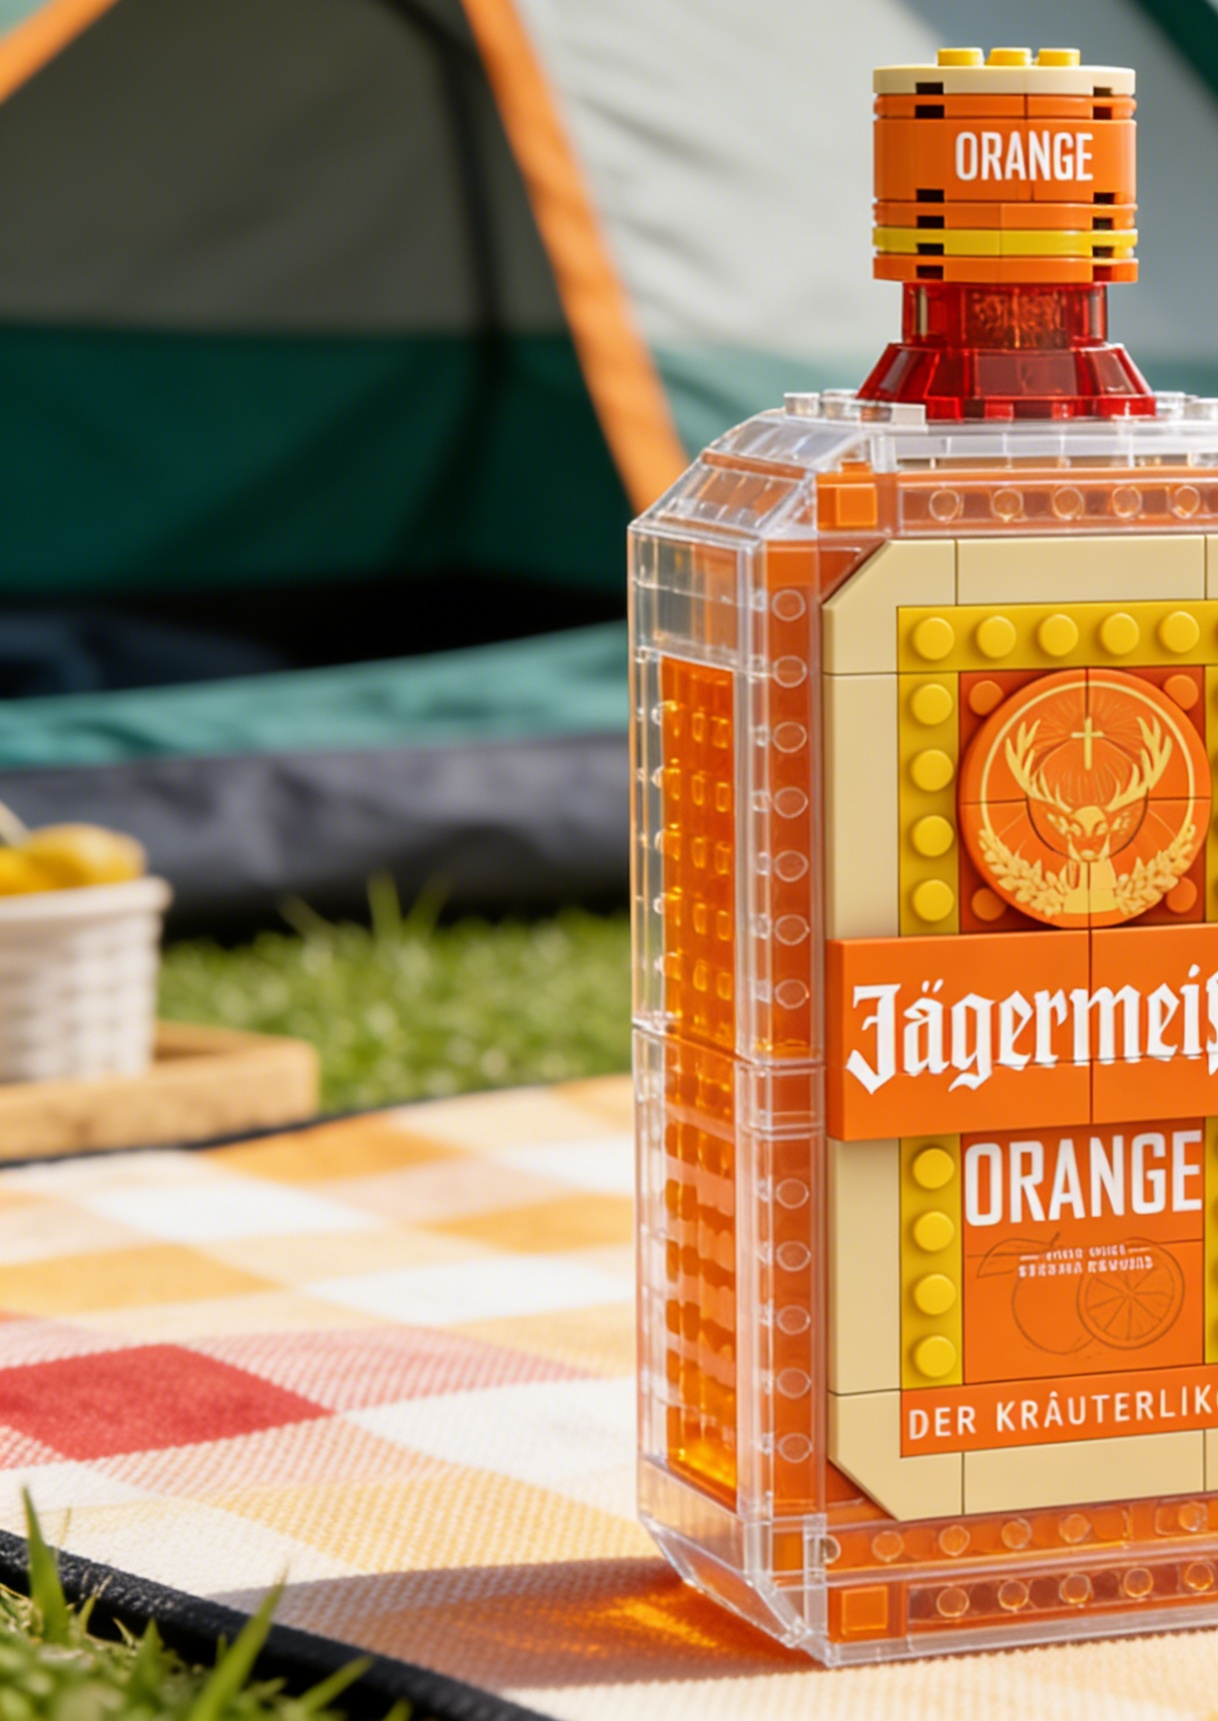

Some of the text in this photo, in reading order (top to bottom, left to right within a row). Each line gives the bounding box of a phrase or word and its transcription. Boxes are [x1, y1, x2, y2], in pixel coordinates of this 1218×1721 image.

[955, 130, 1093, 181] ORANGE
[965, 1130, 1203, 1227] ORANGE
[908, 1405, 976, 1440] DER
